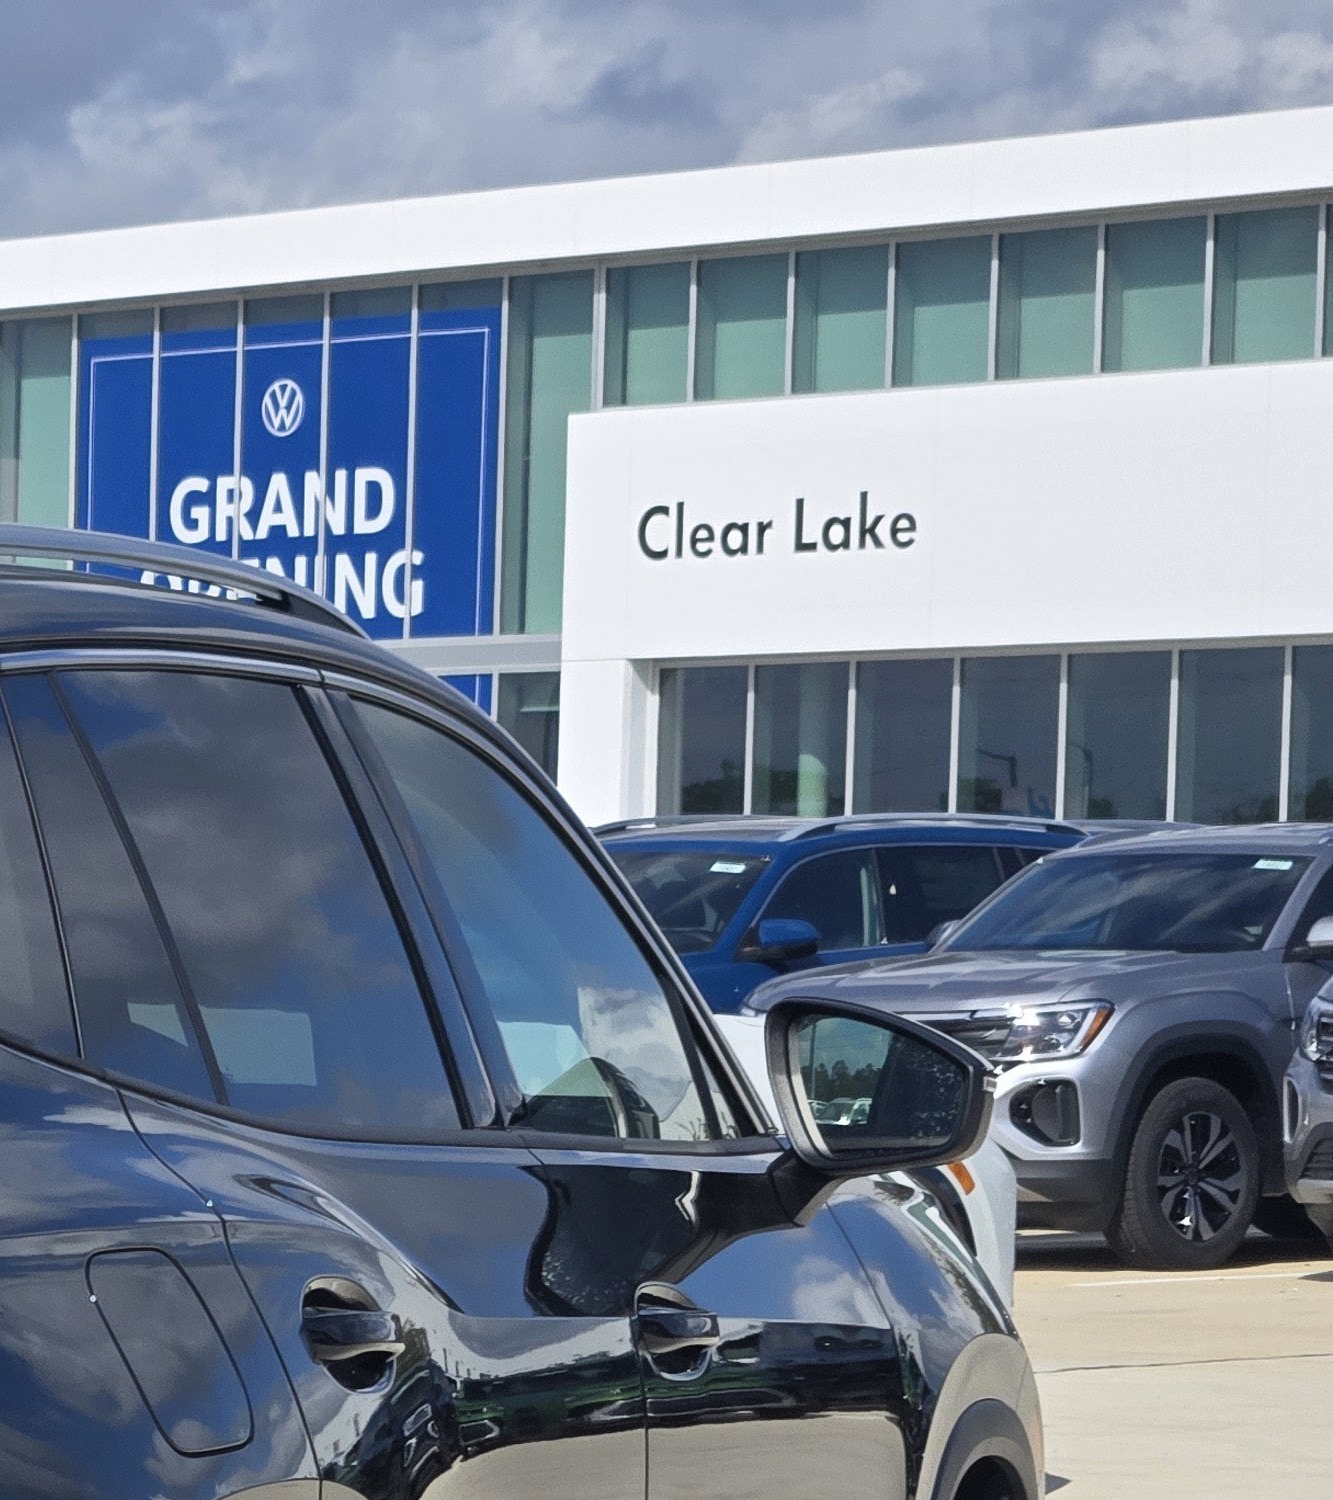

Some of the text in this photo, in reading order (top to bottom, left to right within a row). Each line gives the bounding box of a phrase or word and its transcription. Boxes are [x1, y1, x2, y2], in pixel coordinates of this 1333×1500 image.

[169, 466, 396, 544] GRAND
[638, 490, 917, 561] Clear Lake
